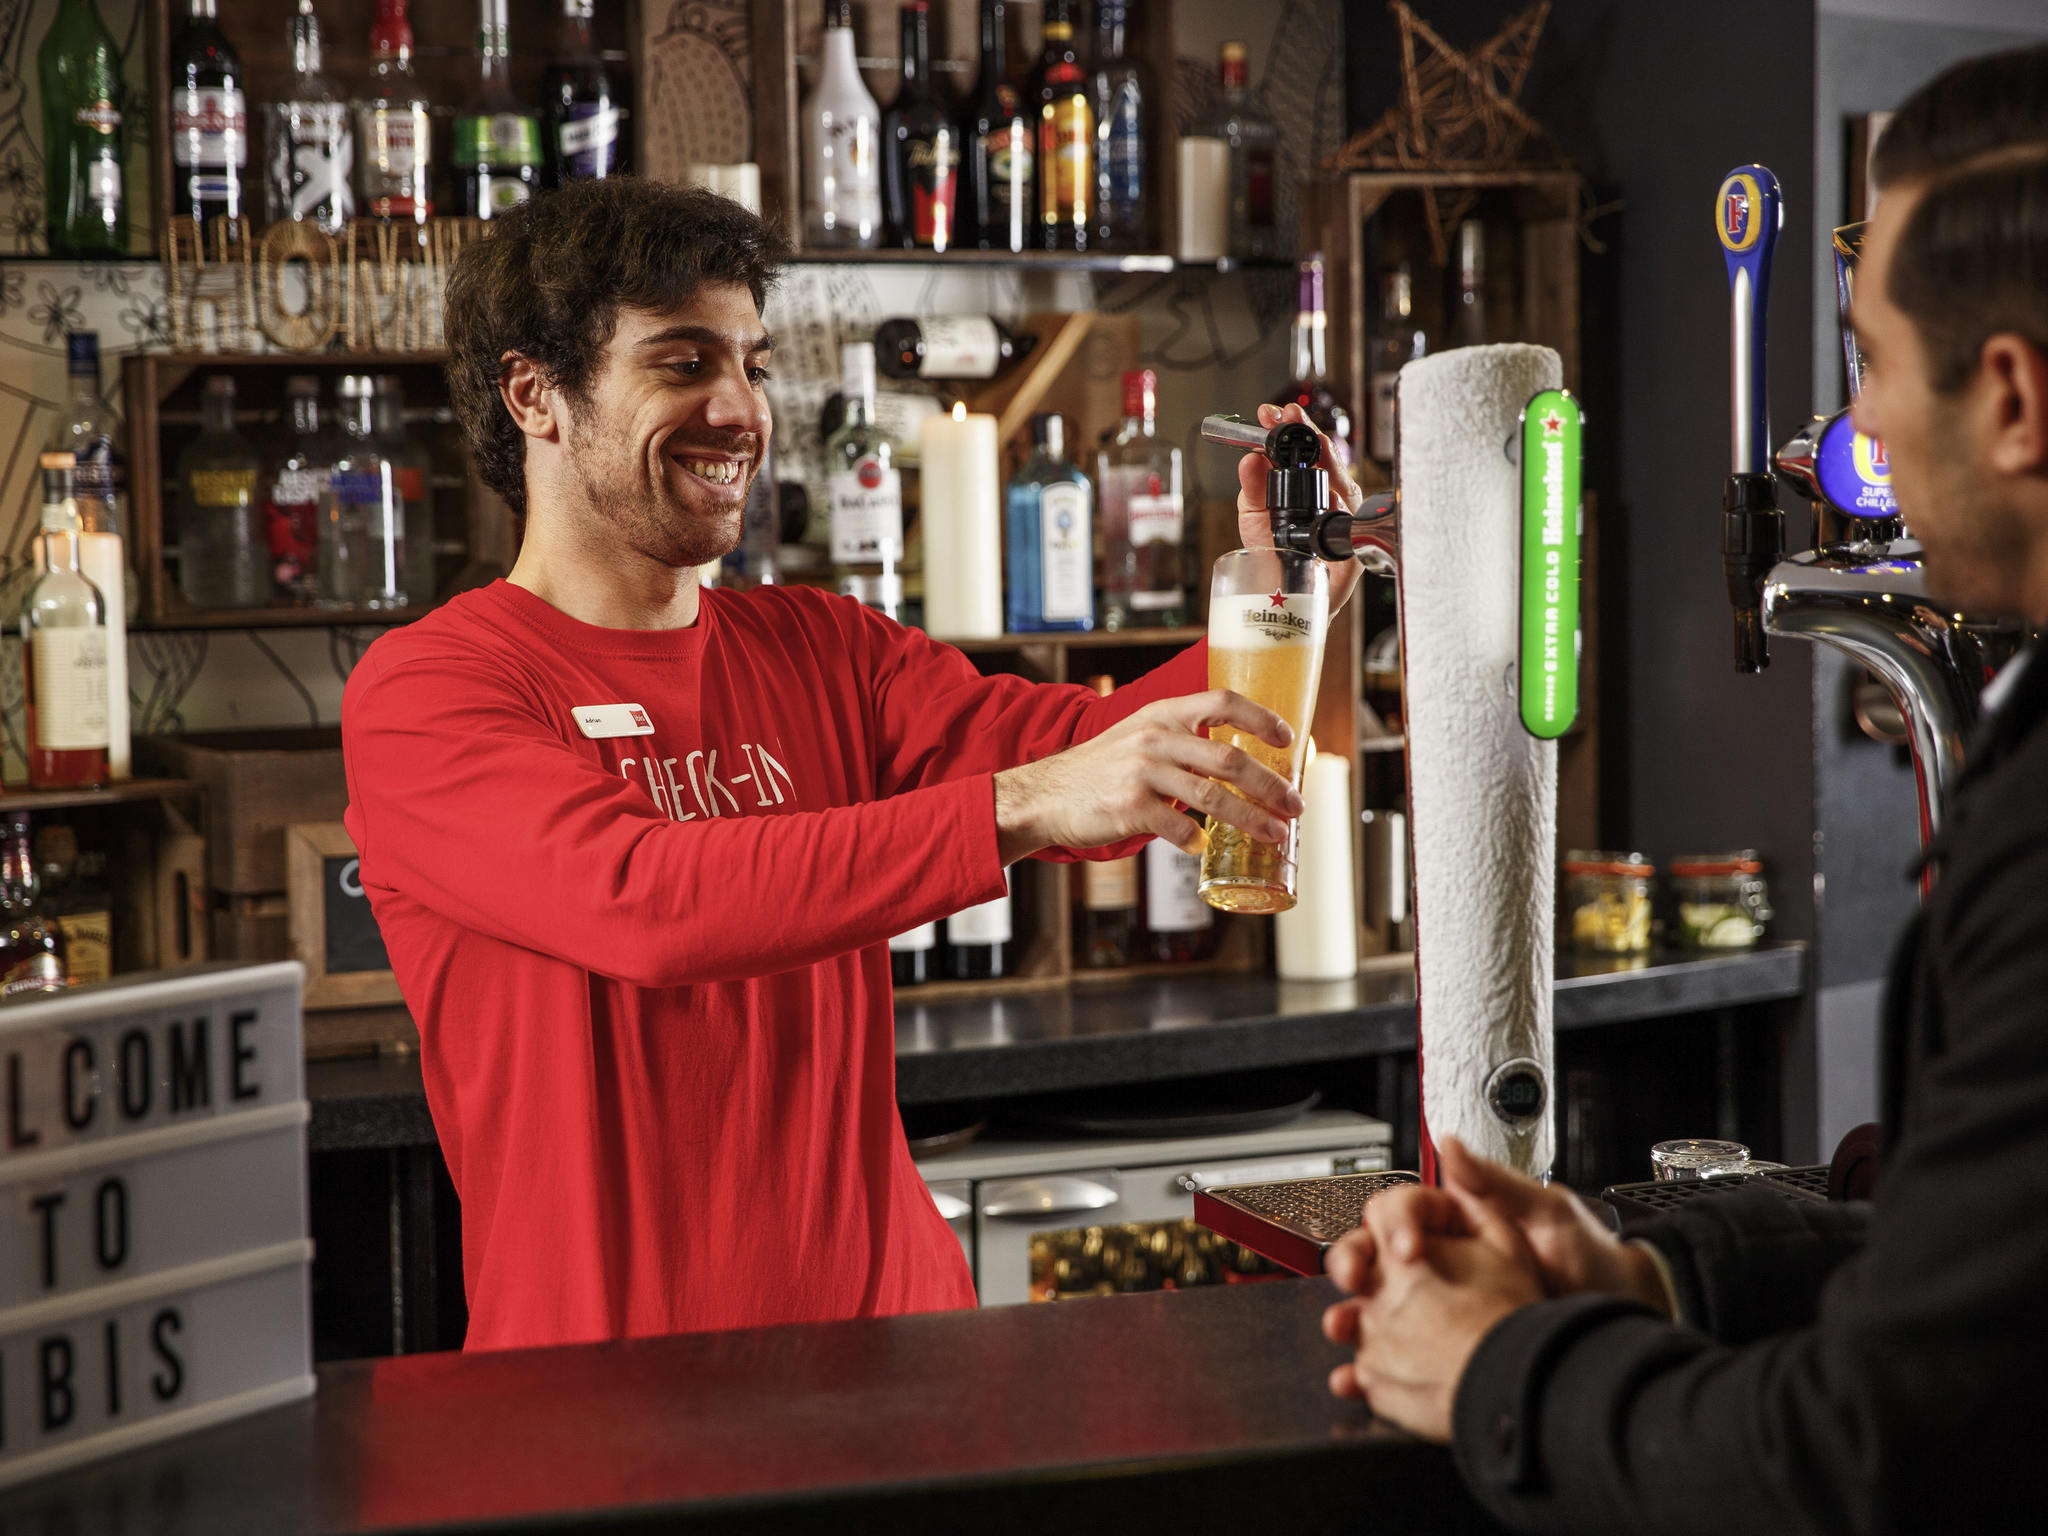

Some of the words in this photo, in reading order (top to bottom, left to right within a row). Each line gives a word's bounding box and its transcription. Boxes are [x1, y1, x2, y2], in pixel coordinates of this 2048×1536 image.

[1727, 194, 1747, 234] F
[1542, 441, 1563, 545] Heineken
[1862, 486, 1894, 497] SUPE
[1545, 550, 1560, 603] COLD
[1544, 607, 1559, 672] EXTRA
[31, 1177, 128, 1289] TO
[0, 1308, 184, 1448] BIS
